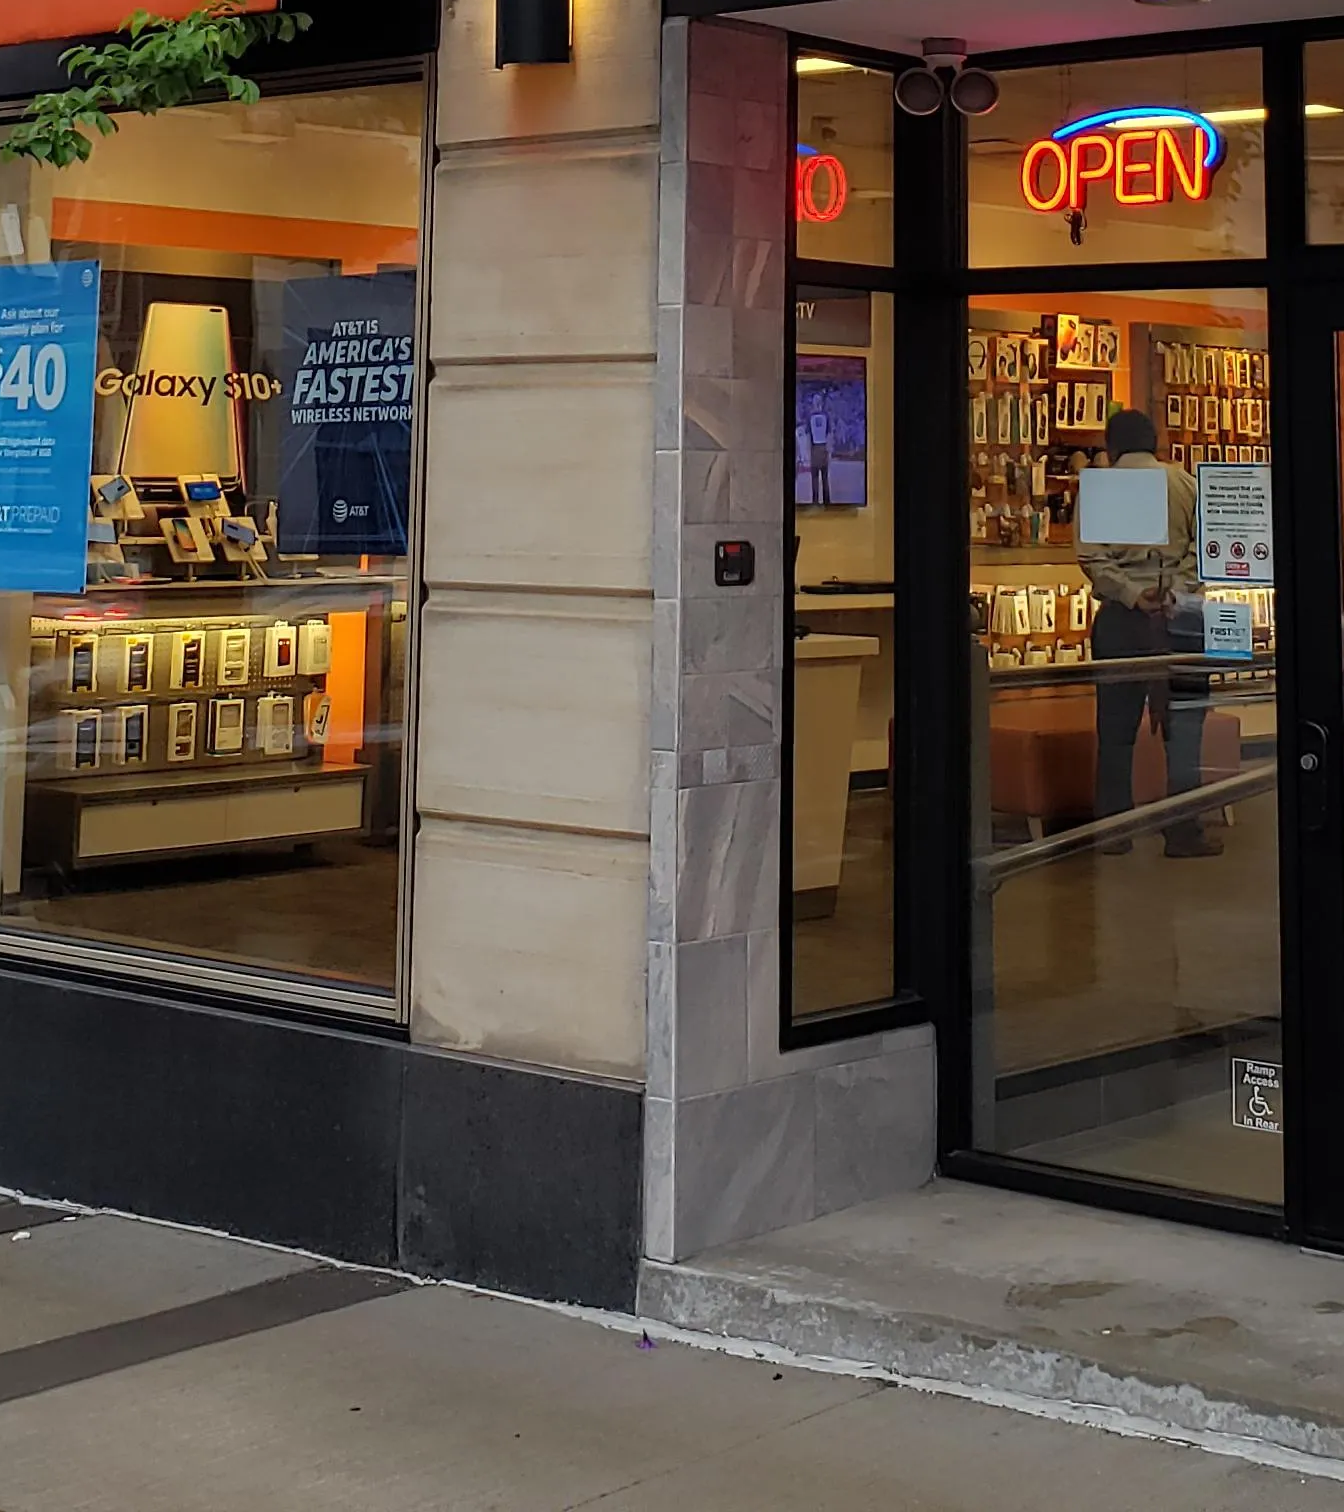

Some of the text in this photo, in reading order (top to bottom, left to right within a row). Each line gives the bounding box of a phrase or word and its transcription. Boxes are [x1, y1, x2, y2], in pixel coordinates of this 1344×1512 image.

[1021, 126, 1209, 212] OPEN
[796, 302, 816, 320] TV
[332, 319, 379, 337] AT&T IS
[303, 336, 412, 366] AMERICA'S
[94, 367, 283, 407] Galaxy S10+
[292, 364, 415, 405] FASTEST
[291, 406, 351, 424] WIRELESS
[11, 506, 61, 523] PREPAID
[349, 505, 369, 517] AT&T
[1246, 1062, 1276, 1078] Ramp
[1243, 1073, 1280, 1088] Access
[1243, 1114, 1280, 1130] In Rear
